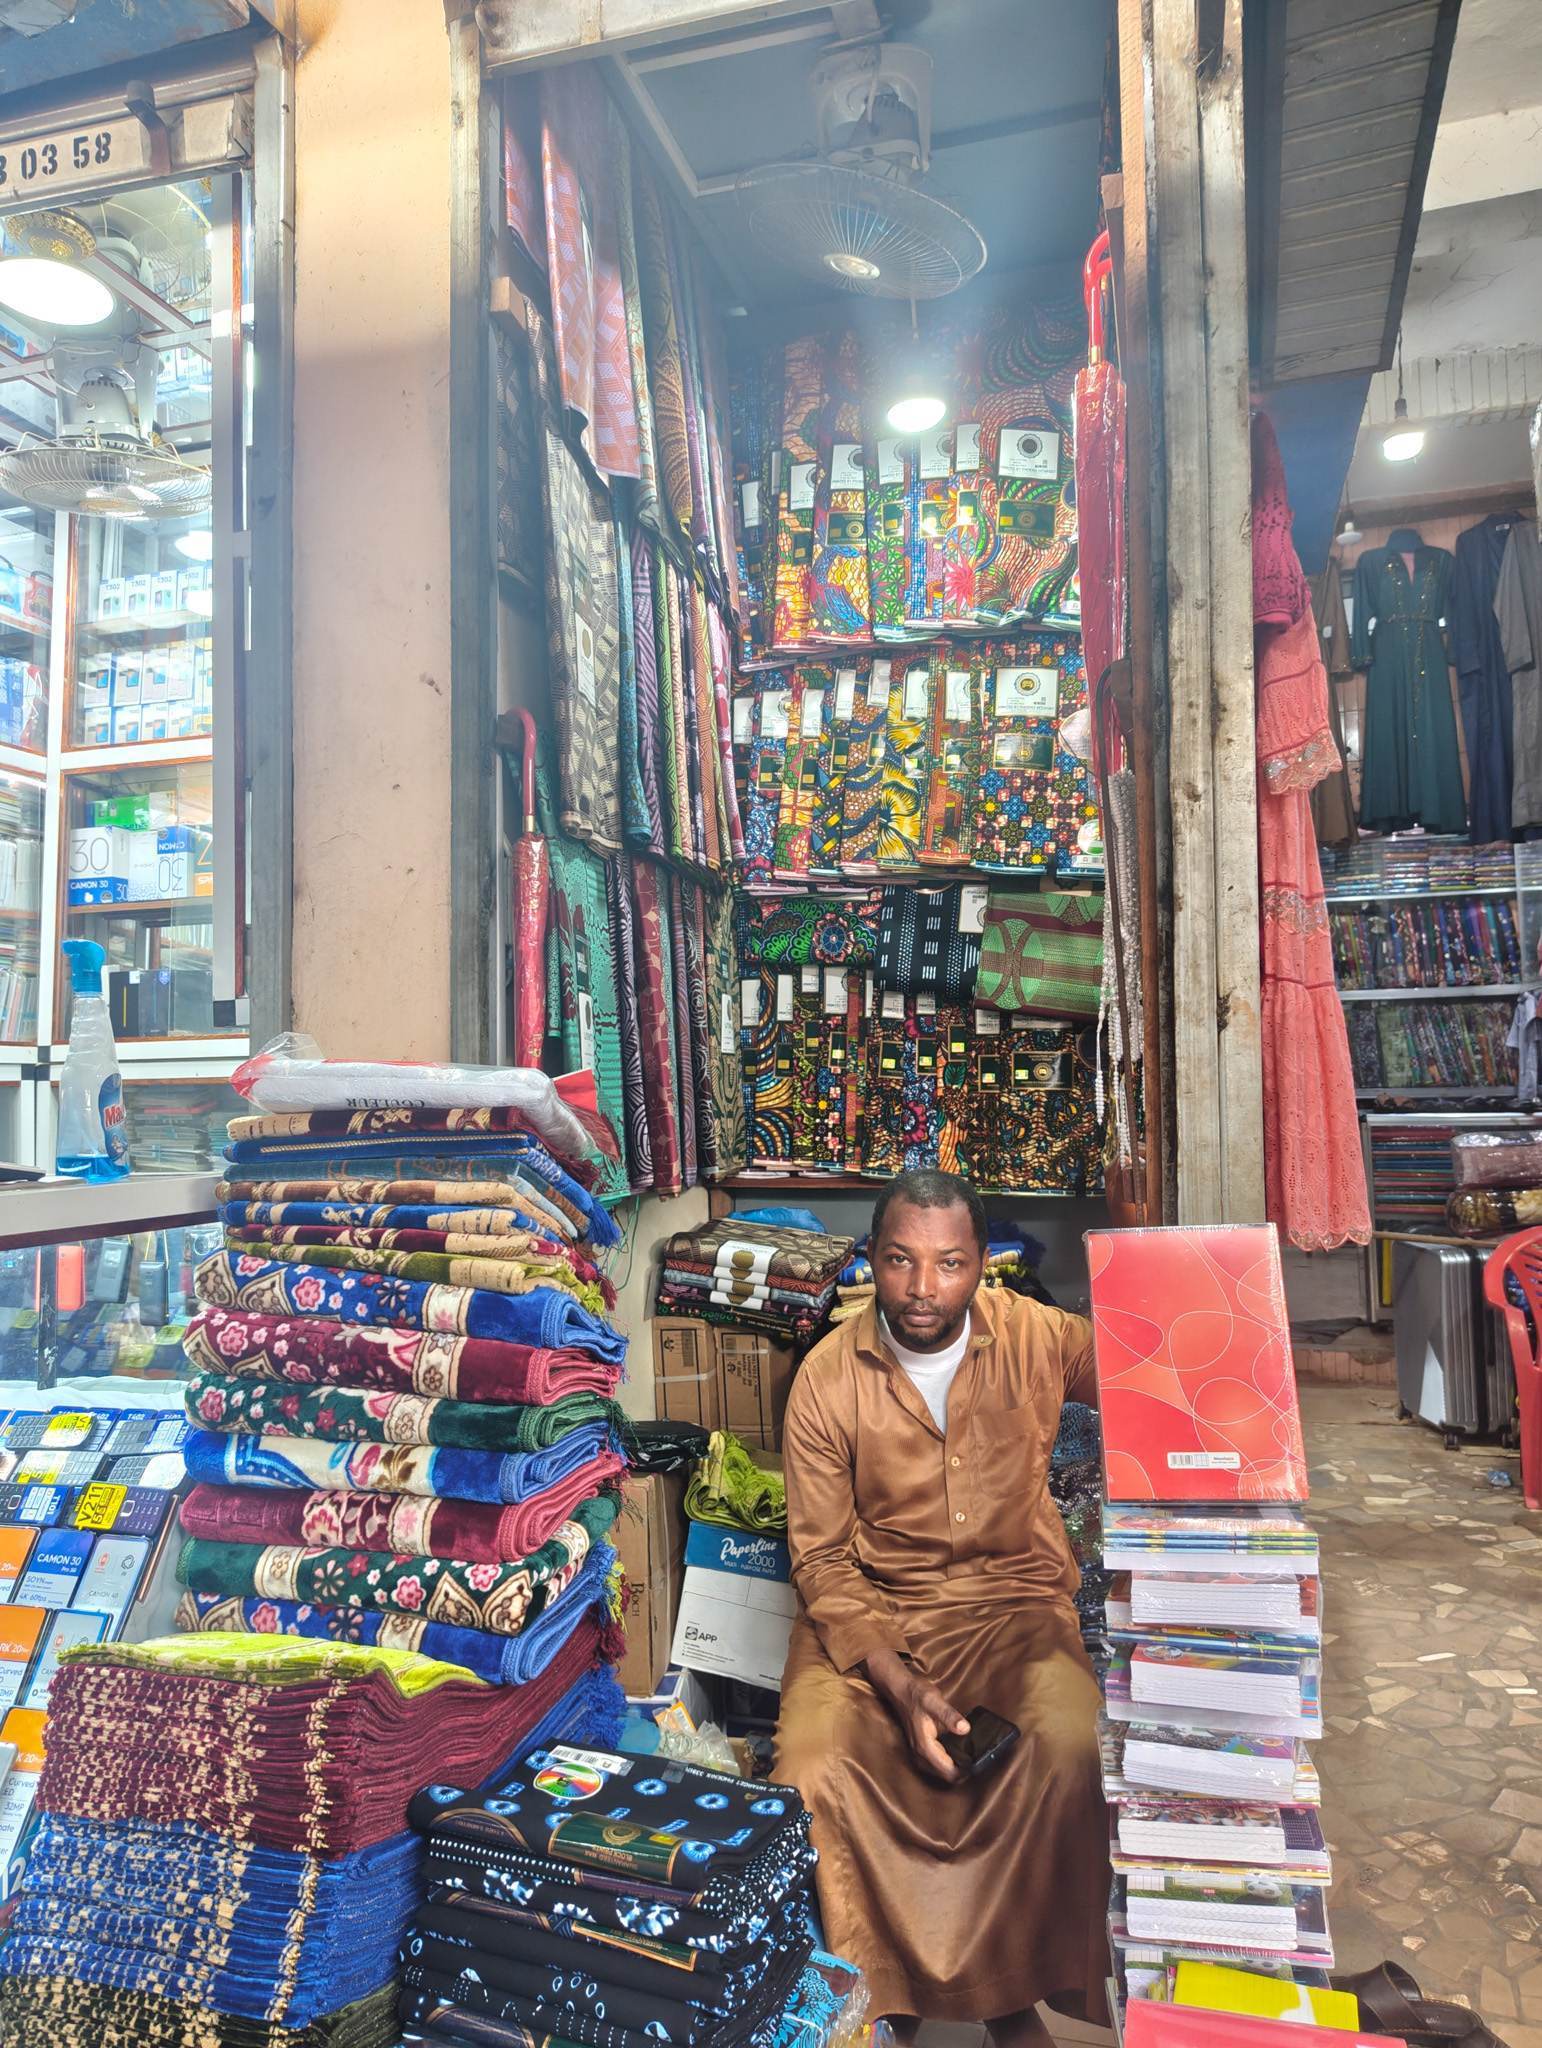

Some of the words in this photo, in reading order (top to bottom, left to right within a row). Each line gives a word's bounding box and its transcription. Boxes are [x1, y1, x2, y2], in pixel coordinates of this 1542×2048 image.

[21, 144, 58, 180] 03
[73, 132, 112, 169] 58
[70, 837, 110, 873] 30
[70, 880, 97, 889] CAMON
[345, 1098, 425, 1108] COULEUR
[720, 1537, 777, 1561] Paperline
[37, 1553, 70, 1566] CAMON
[70, 1556, 82, 1566] 30
[747, 1553, 776, 1568] 2000
[698, 1632, 718, 1643] APP
[8, 1777, 35, 1788] Curved
[706, 1773, 735, 1784] PHOENIX
[612, 1850, 633, 1861] BLOCK
